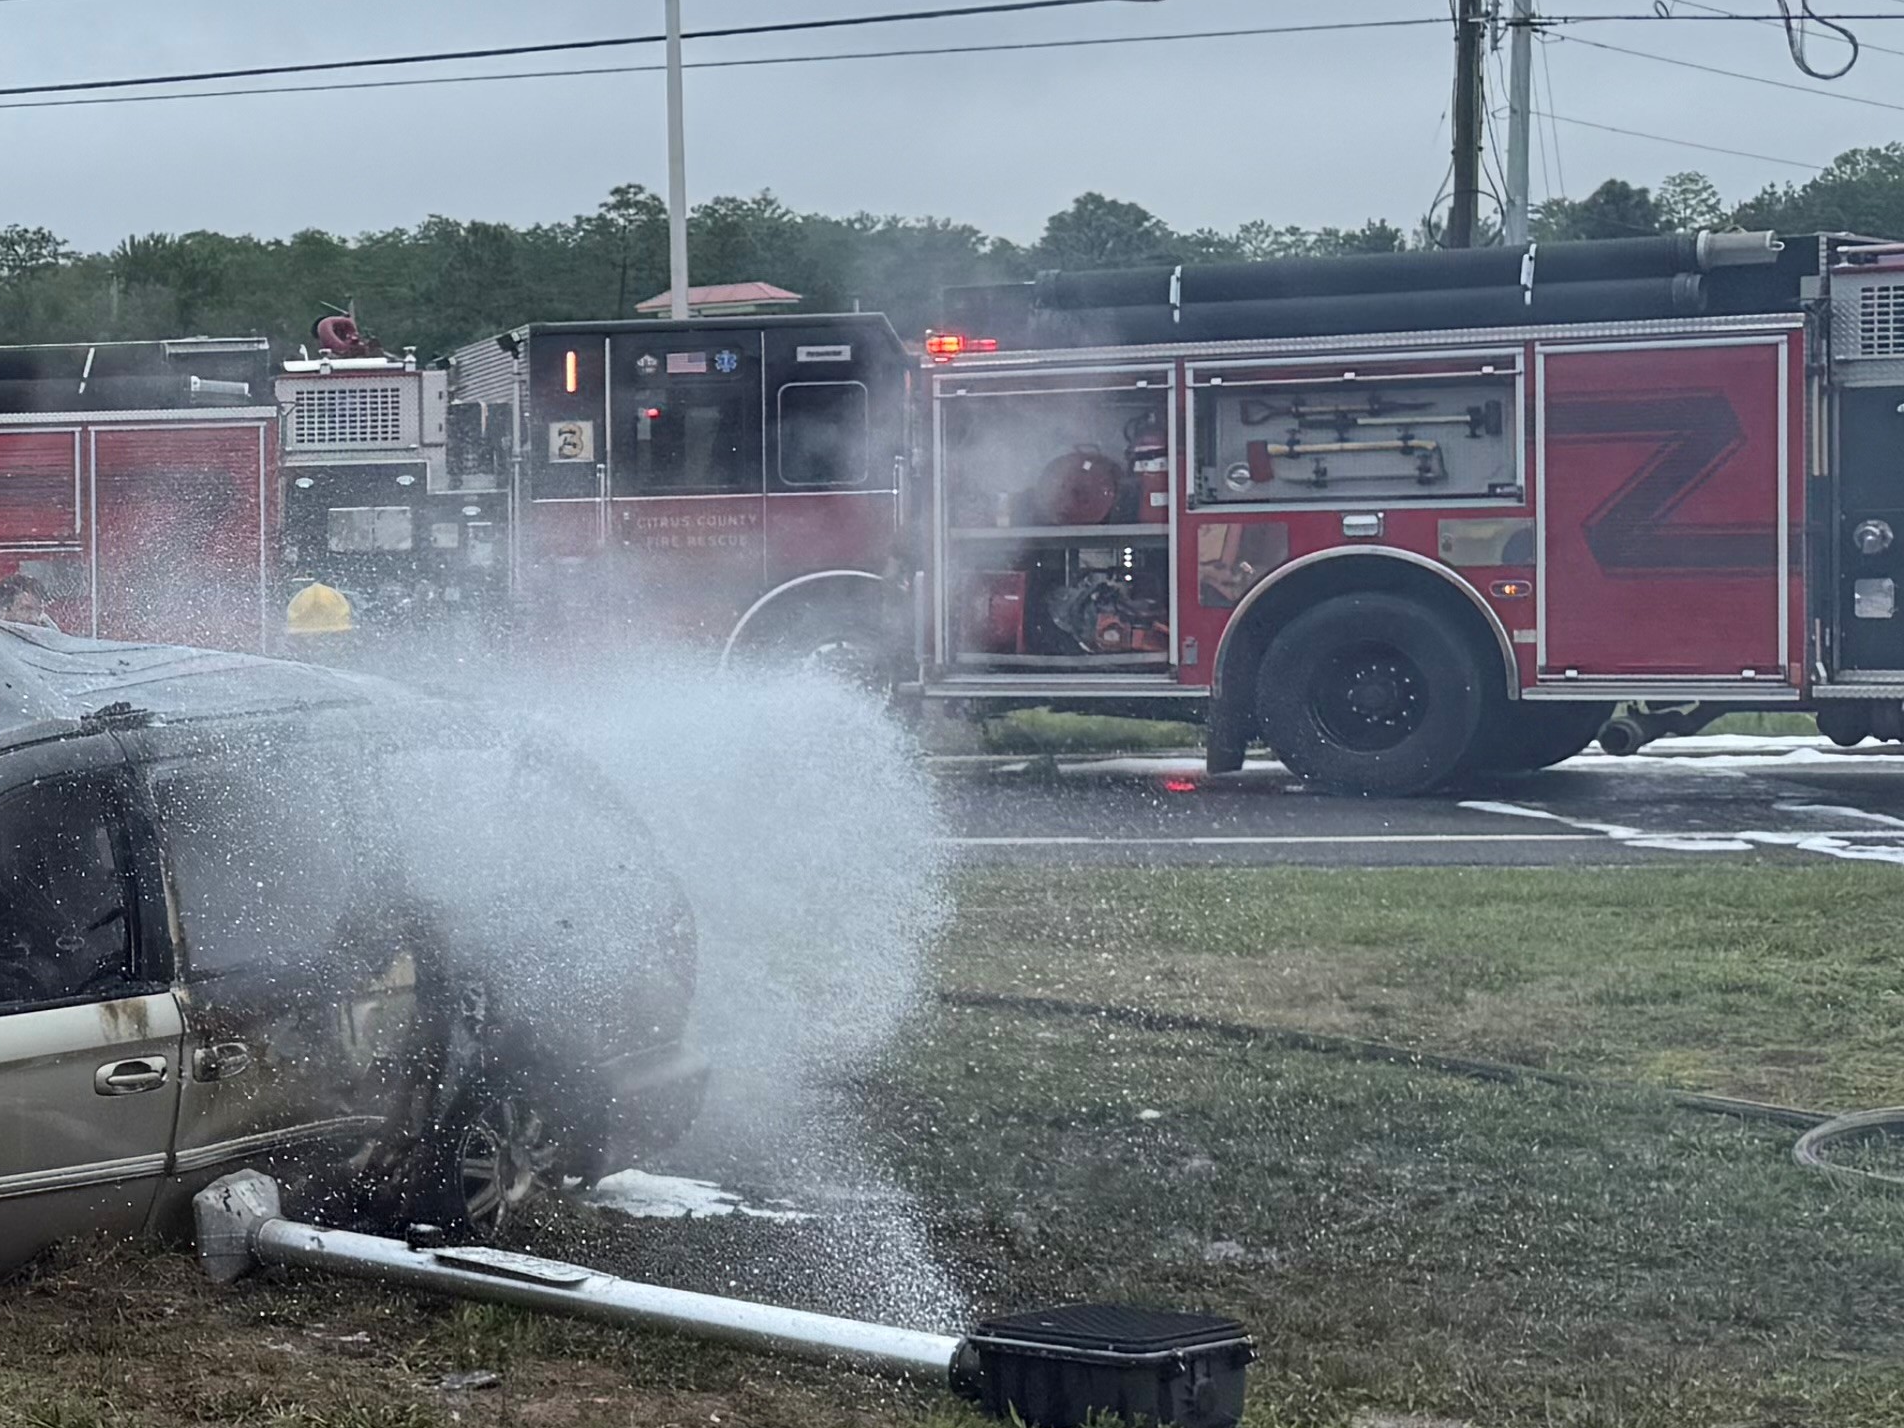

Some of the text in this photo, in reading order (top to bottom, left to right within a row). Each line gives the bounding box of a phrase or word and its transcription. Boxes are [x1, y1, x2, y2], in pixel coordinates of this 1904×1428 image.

[558, 423, 584, 459] 3
[636, 513, 758, 529] CITRUS COUNTY
[687, 534, 746, 547] RESCUE
